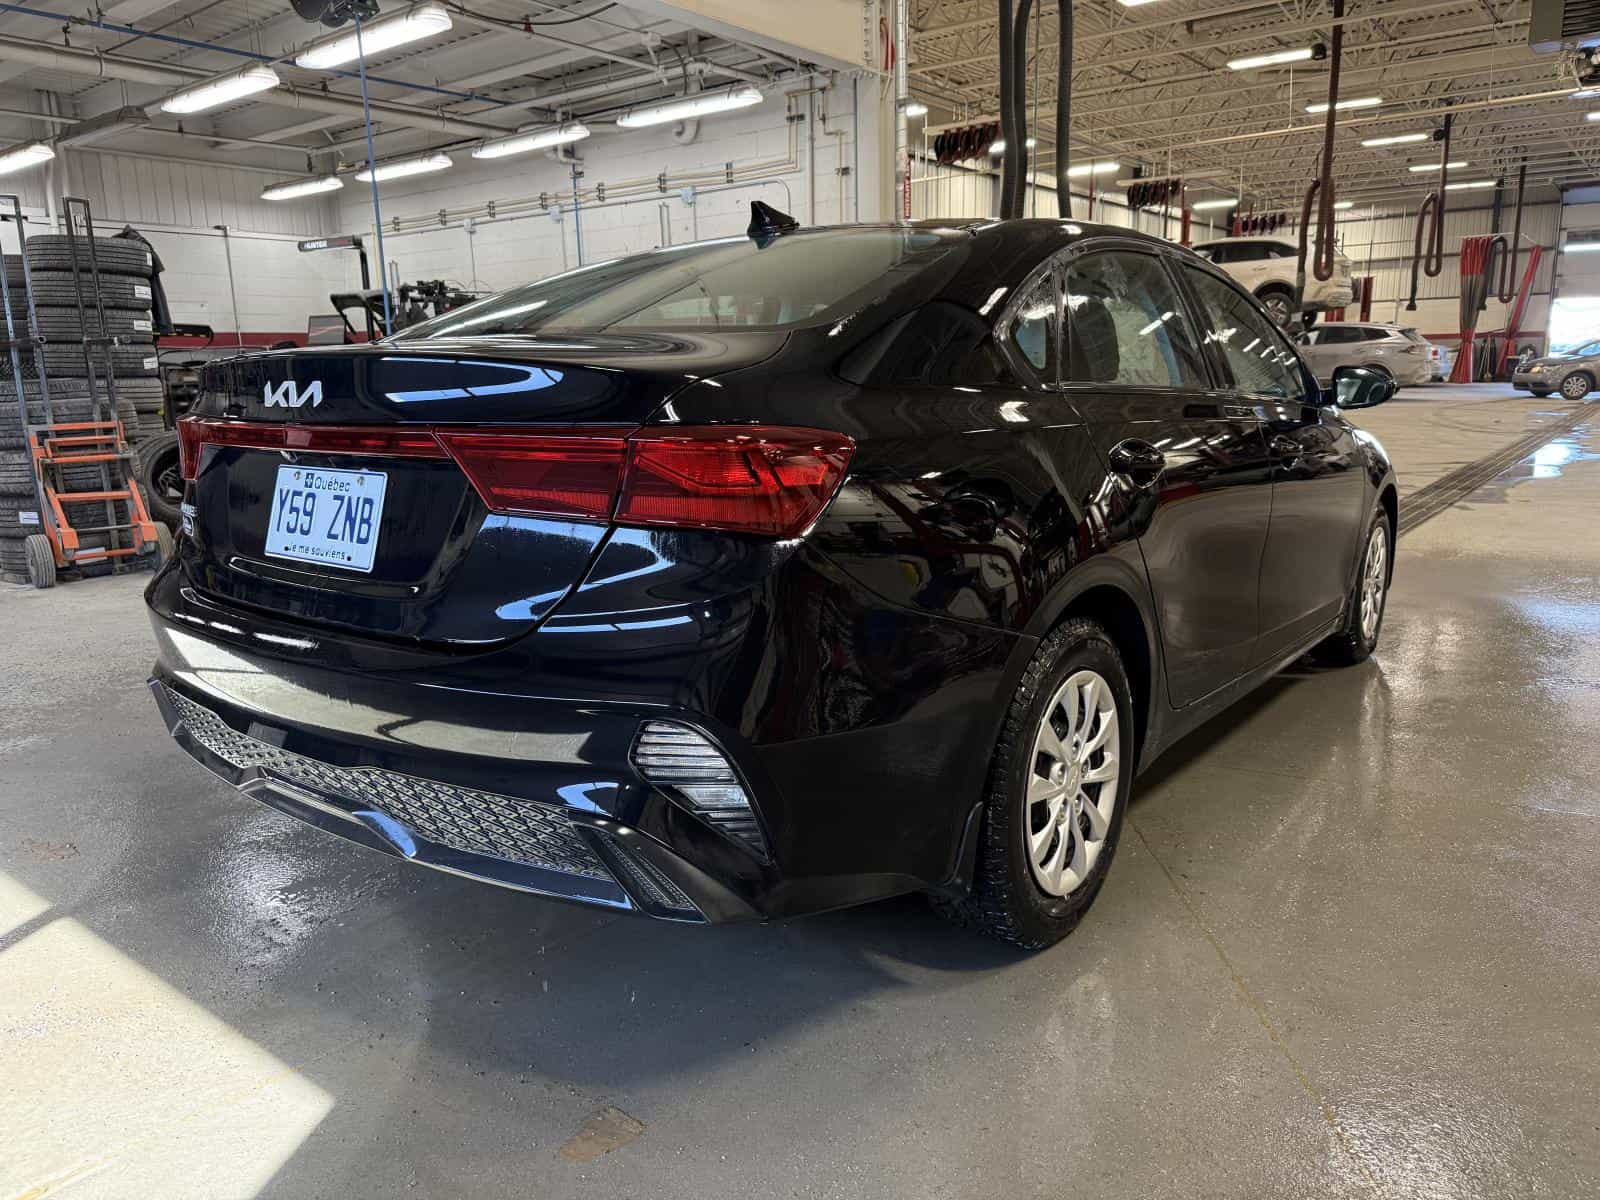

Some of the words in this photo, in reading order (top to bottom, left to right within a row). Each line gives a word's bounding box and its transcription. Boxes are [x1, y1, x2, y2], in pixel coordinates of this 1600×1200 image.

[263, 380, 324, 408] KIA
[314, 476, 351, 492] Québec
[276, 488, 317, 536] Y59
[326, 494, 374, 545] ZNB
[298, 545, 310, 554] me
